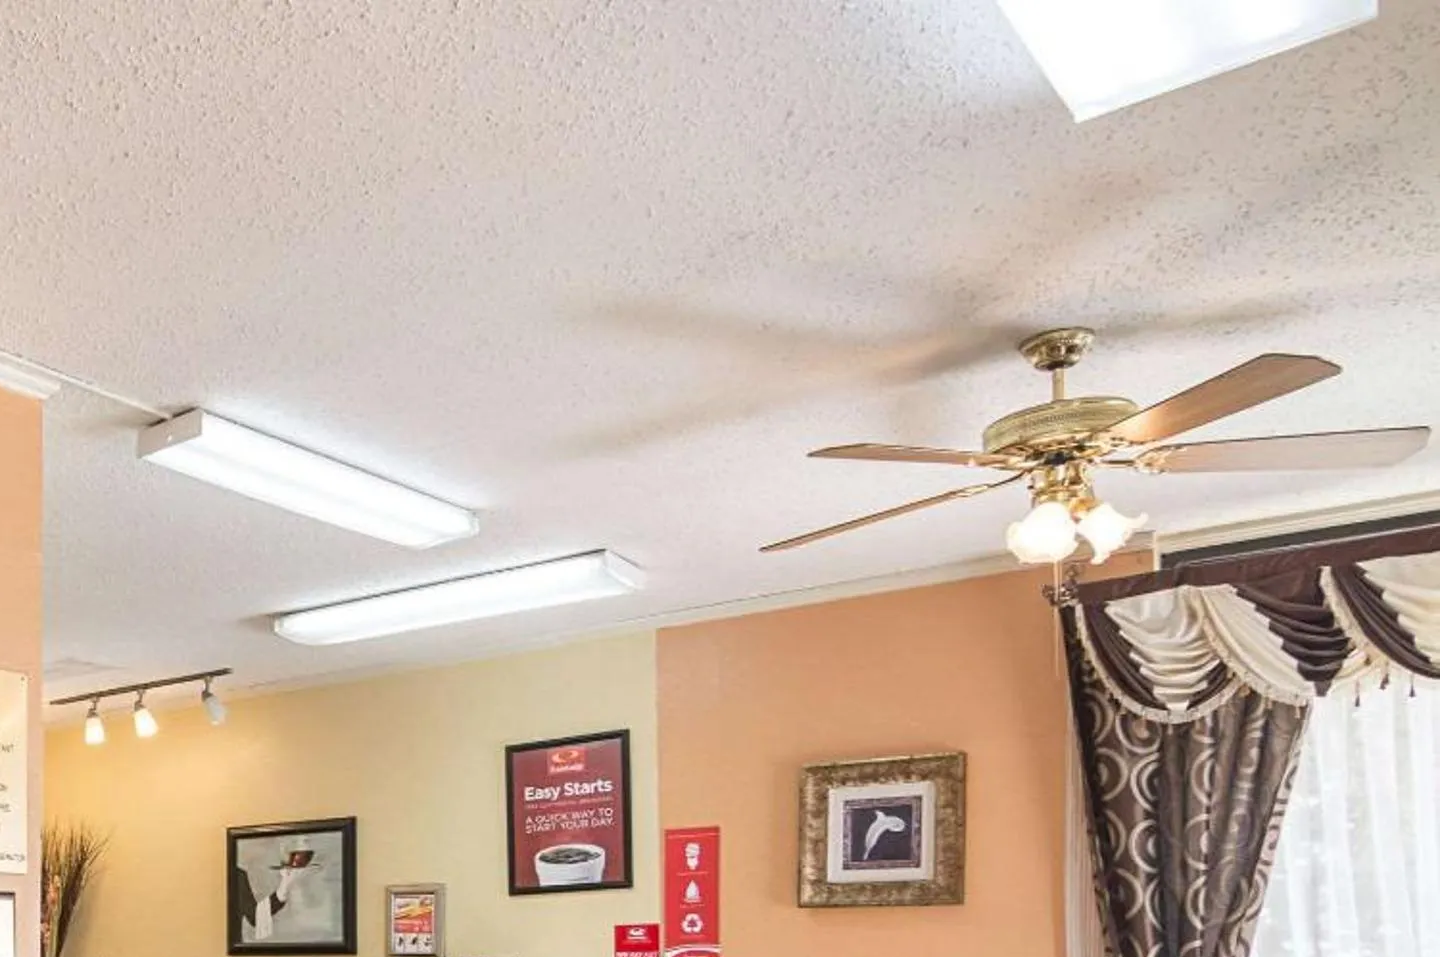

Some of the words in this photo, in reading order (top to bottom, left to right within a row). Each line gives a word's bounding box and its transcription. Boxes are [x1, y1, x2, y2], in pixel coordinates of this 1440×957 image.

[524, 786, 561, 801] Easy
[564, 779, 613, 796] Starts
[525, 815, 533, 824] A
[535, 812, 568, 824] QUICK
[571, 808, 596, 819] WAY
[598, 807, 614, 817] TO
[525, 821, 557, 834] START
[560, 819, 589, 830] YOUR
